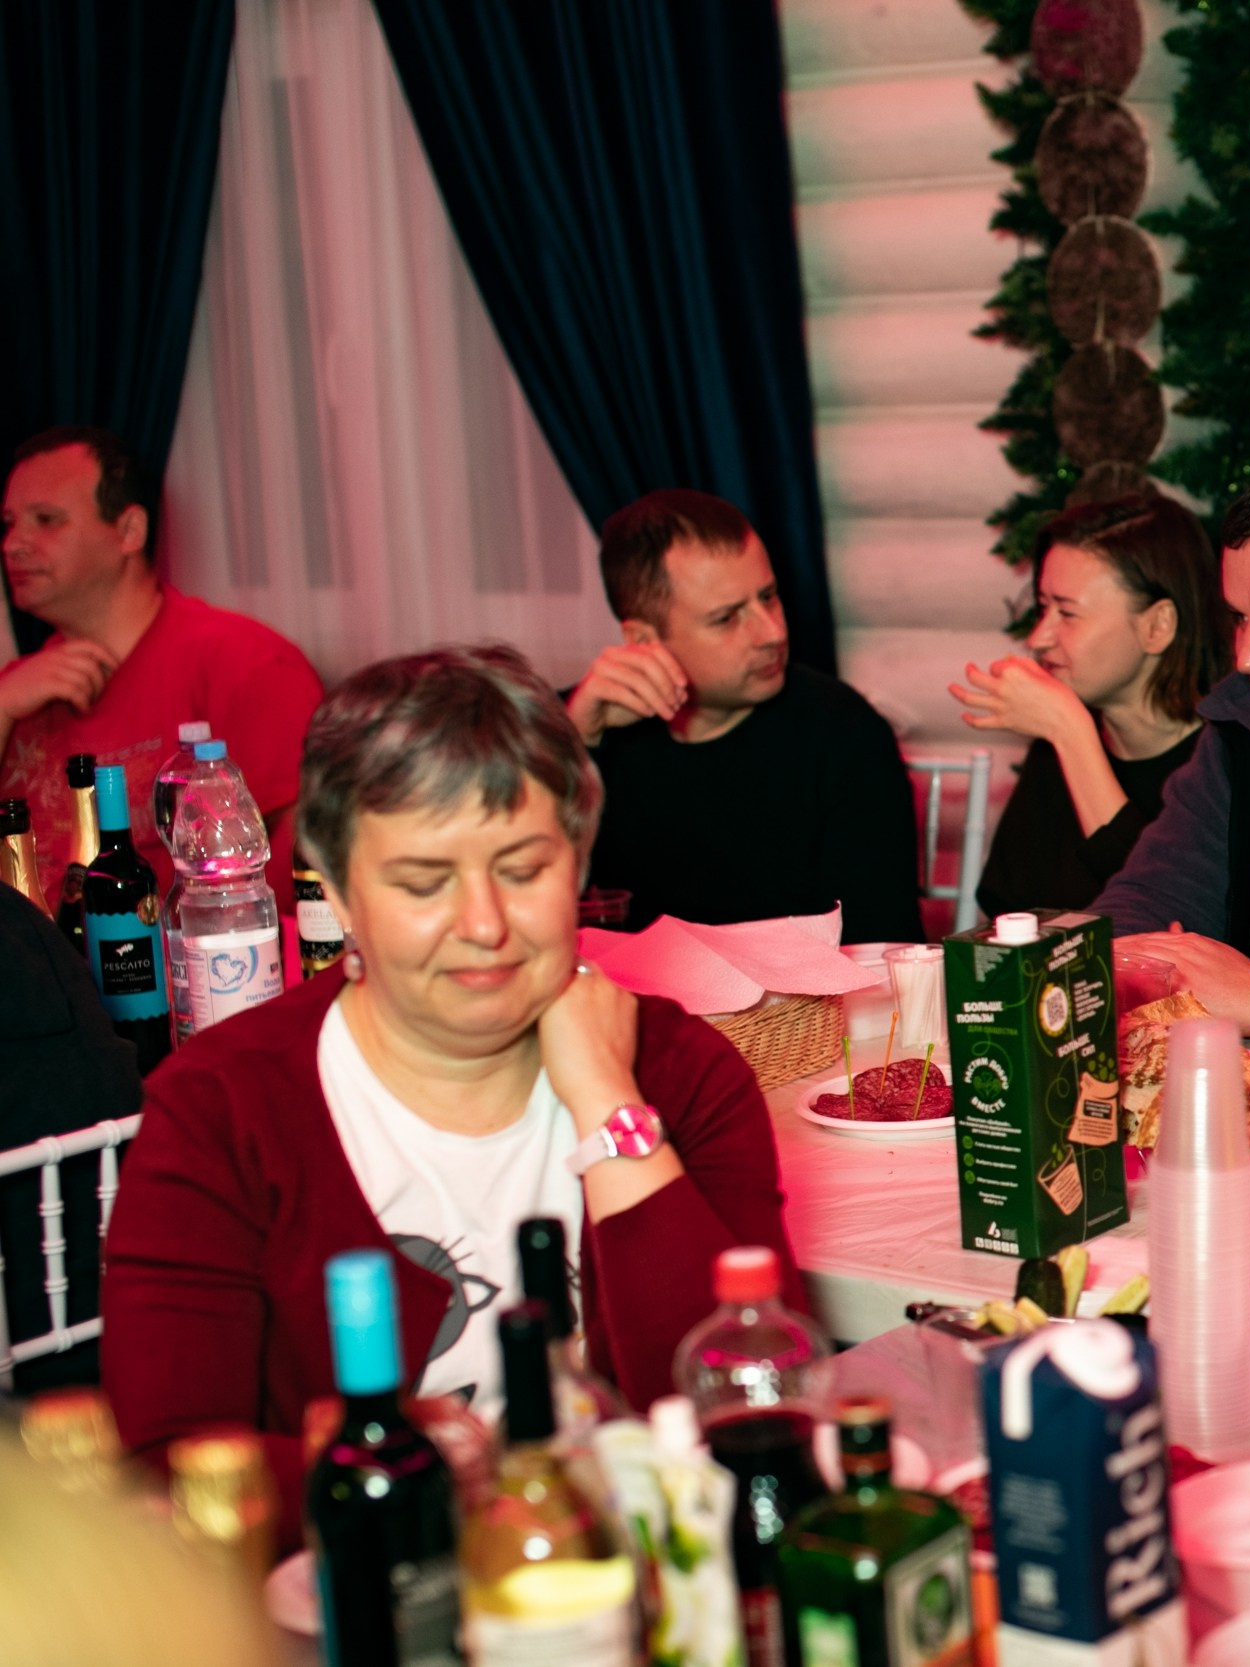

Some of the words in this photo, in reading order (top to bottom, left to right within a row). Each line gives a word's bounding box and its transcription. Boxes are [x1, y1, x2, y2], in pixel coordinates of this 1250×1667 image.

[104, 958, 151, 971] PESCAITO
[963, 1001, 1004, 1012] БОЛЬШЕ
[956, 1013, 995, 1023] ПОЛЬЗЫ
[970, 1096, 1006, 1113] ВМЕСТЕ
[1106, 1405, 1165, 1620] Rich
